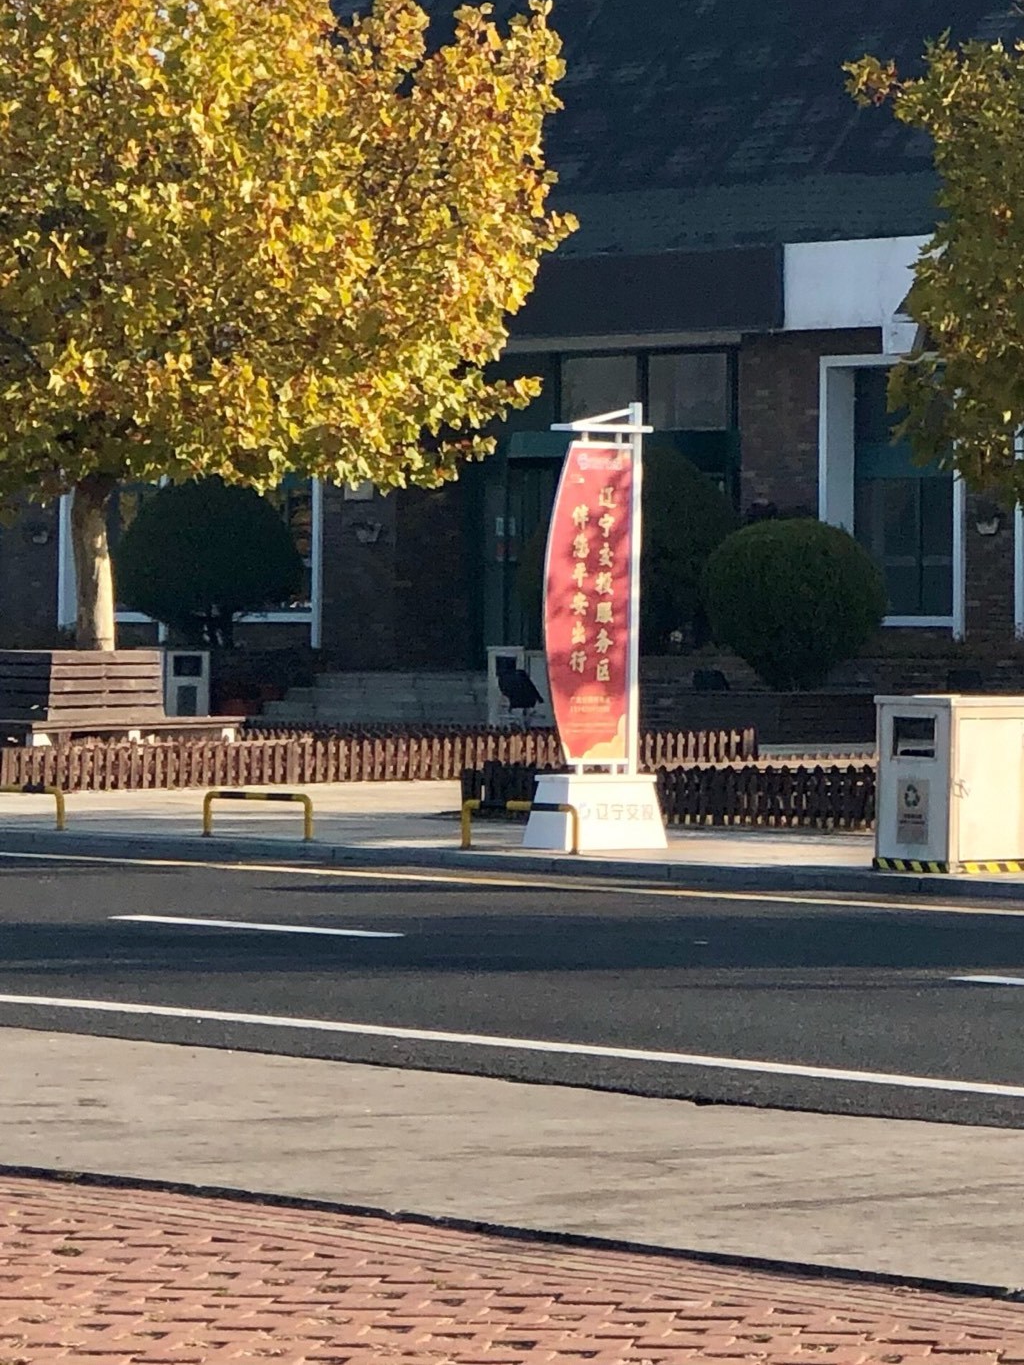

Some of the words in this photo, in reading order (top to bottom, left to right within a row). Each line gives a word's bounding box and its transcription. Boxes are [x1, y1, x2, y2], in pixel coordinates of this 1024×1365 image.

[569, 504, 590, 674] 伴您平安出行
[594, 486, 617, 682] 辽宁交投服务区
